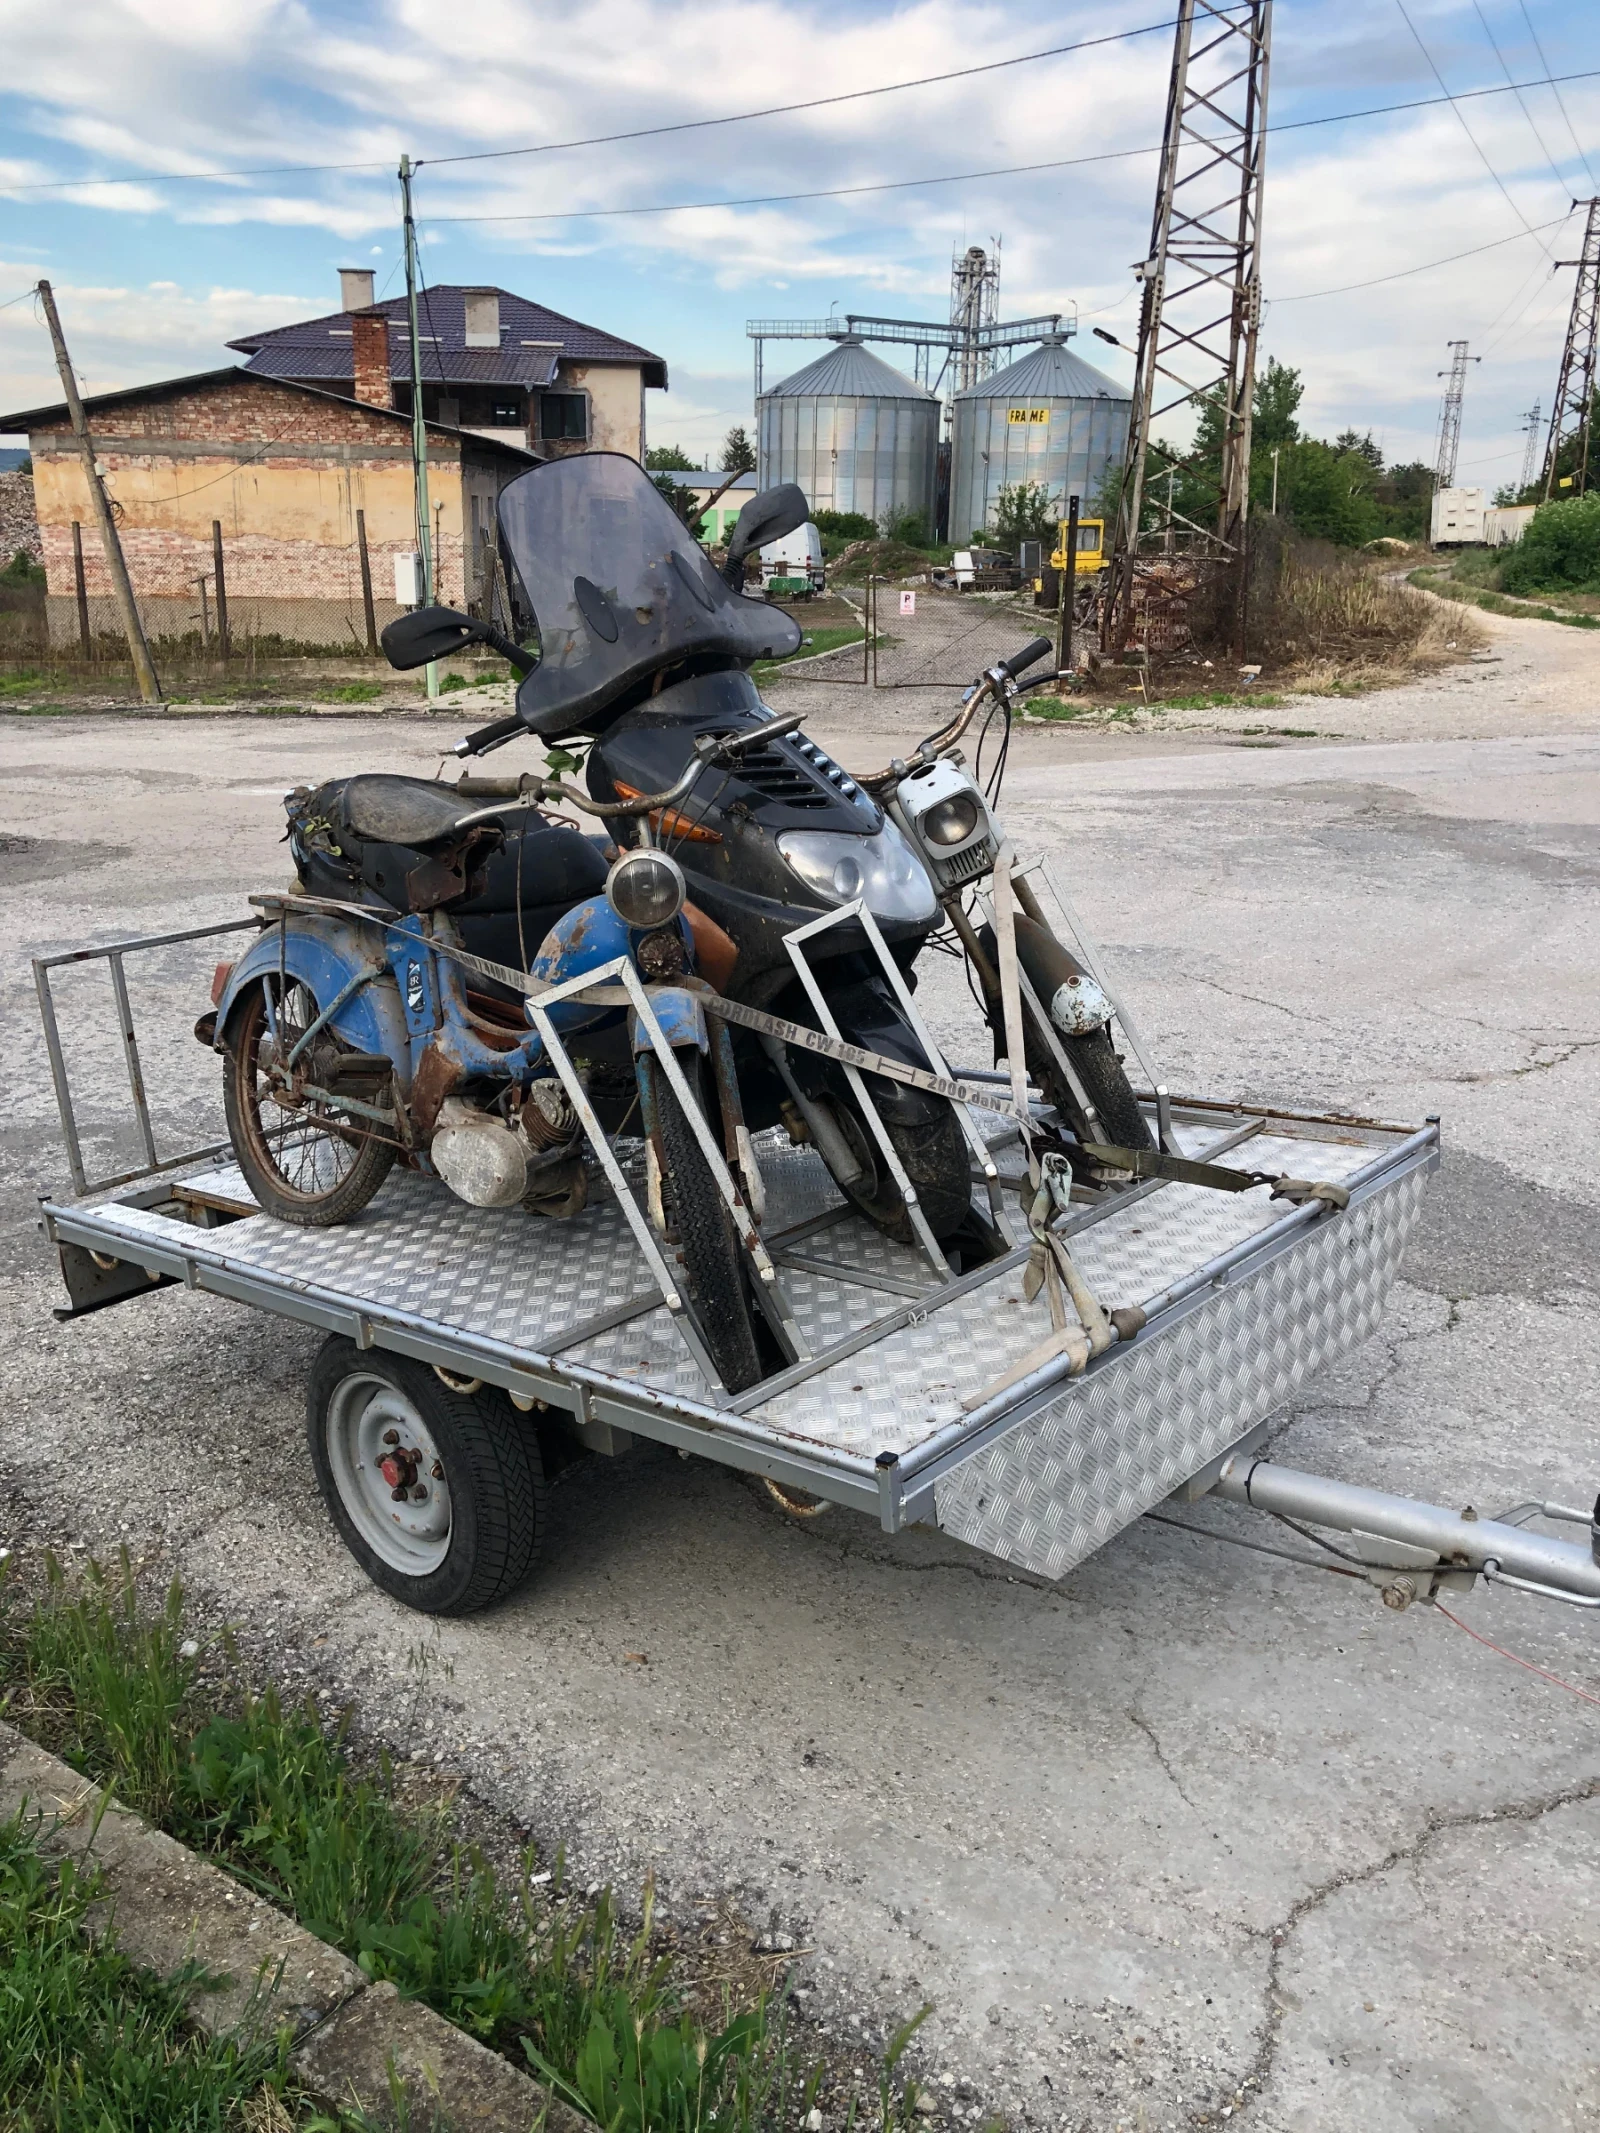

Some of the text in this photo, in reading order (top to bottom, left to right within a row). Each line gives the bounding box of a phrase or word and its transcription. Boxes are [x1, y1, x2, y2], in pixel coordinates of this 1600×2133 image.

[708, 997, 798, 1041] CORDLASH
[805, 1032, 835, 1053] CW
[927, 1075, 967, 1099] 2000
[971, 1092, 1001, 1111] daN
